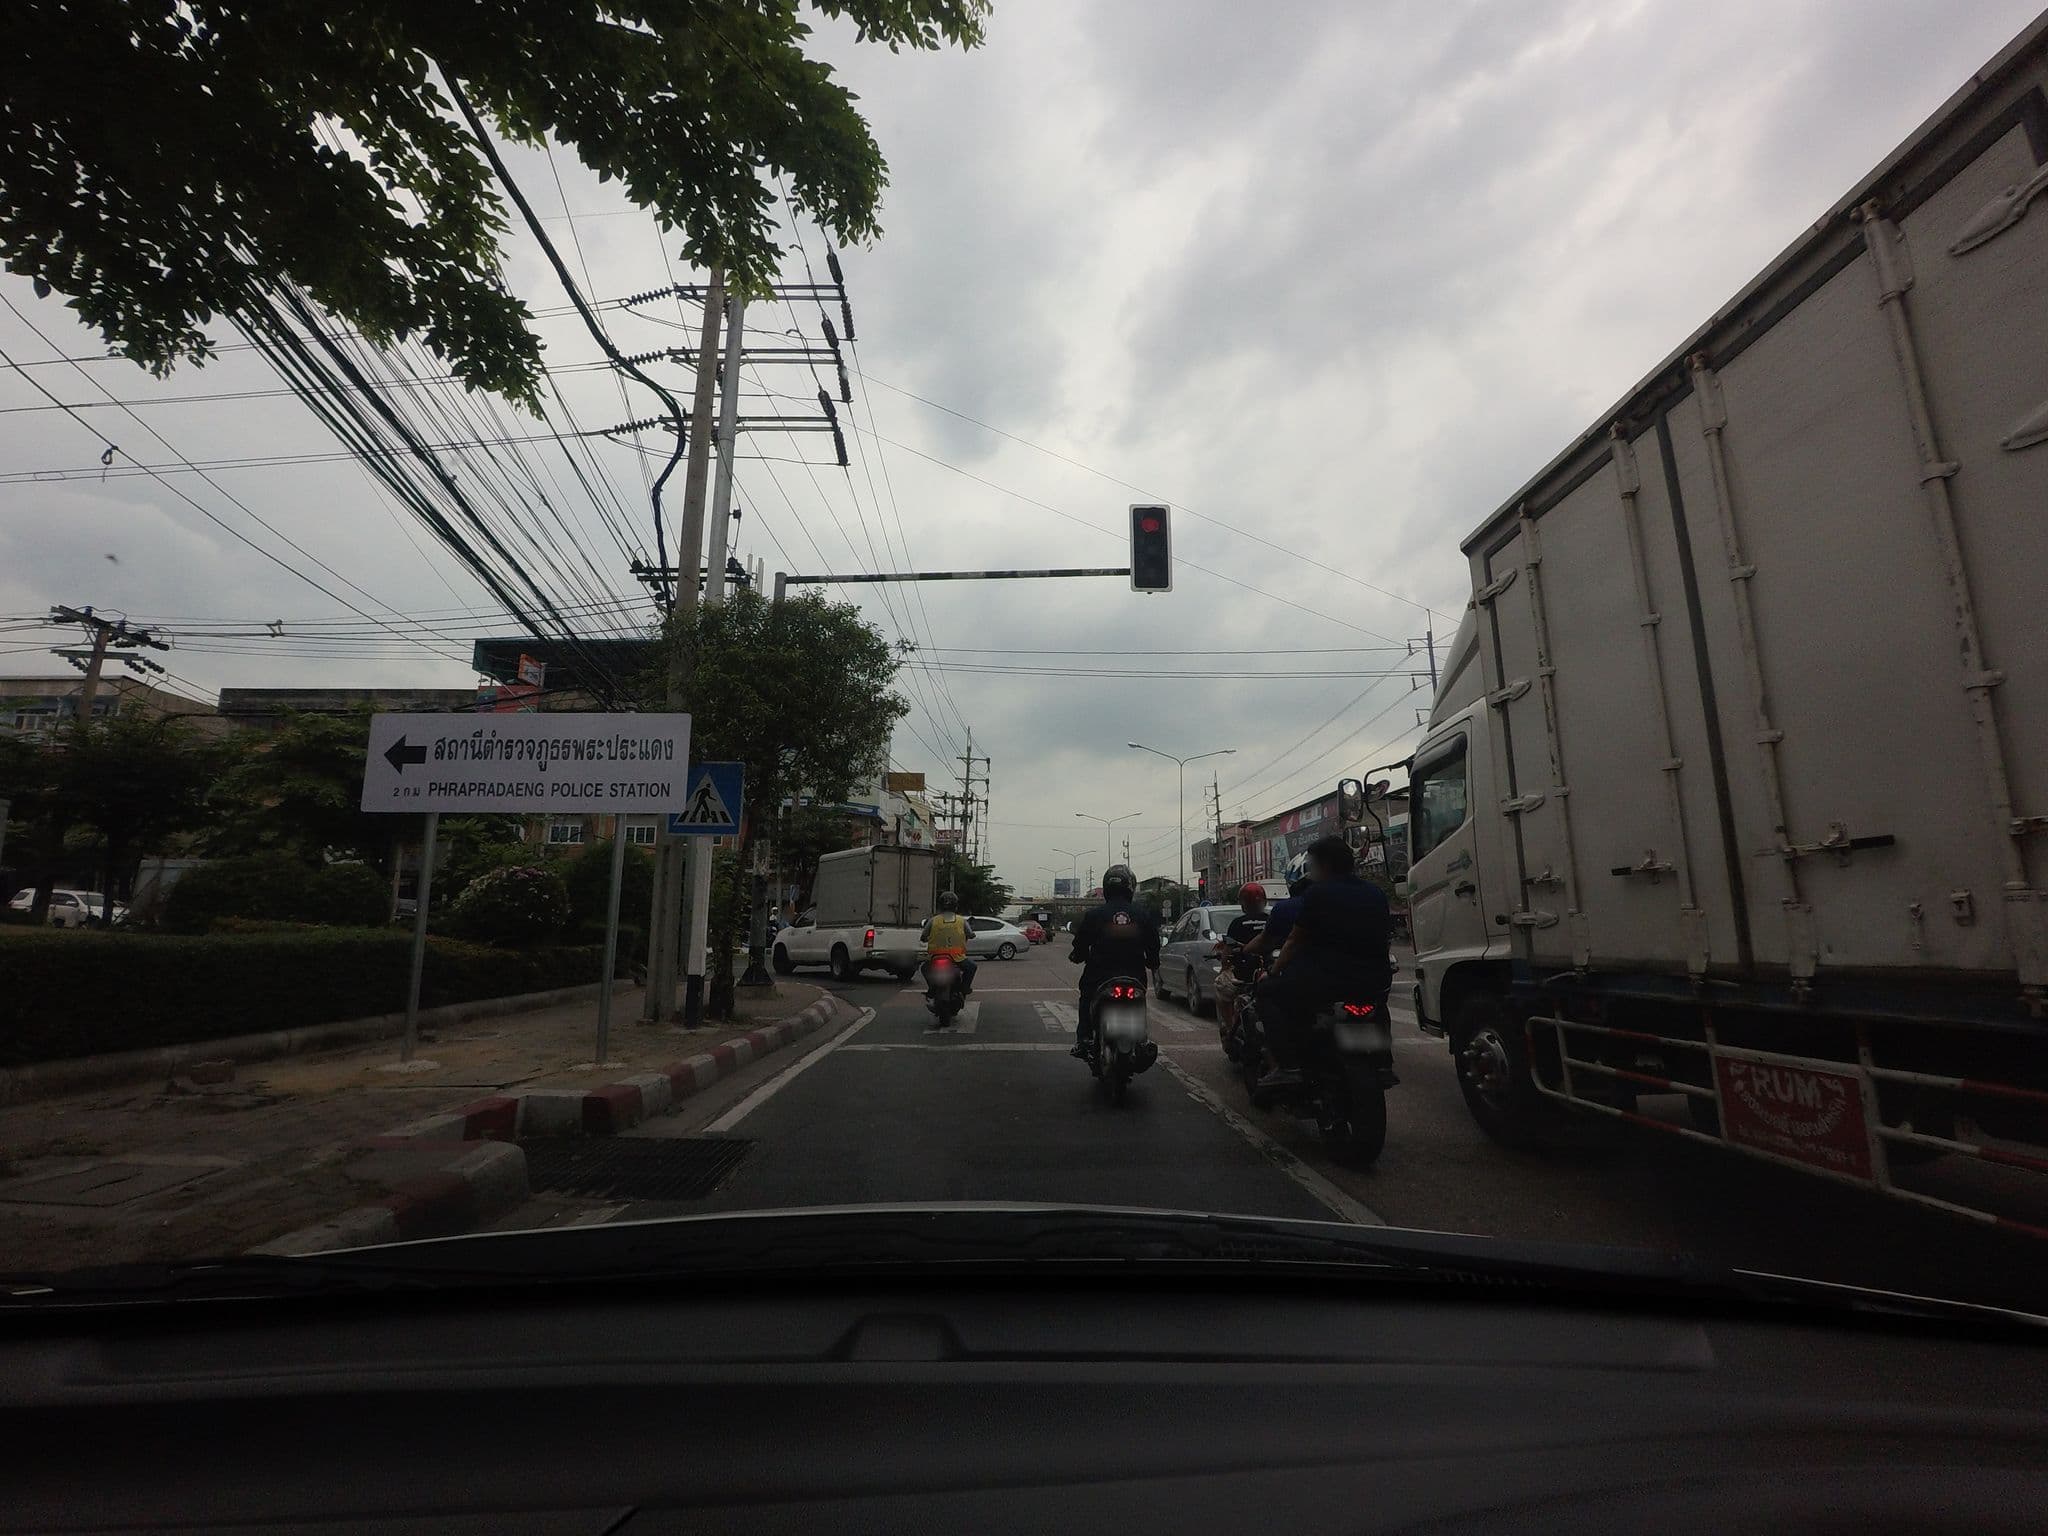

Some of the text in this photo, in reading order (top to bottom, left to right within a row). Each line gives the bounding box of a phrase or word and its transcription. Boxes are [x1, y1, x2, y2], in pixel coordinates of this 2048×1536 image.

[433, 729, 674, 771] สถานีตำรวจภูธรพระประแดง
[393, 787, 400, 797] 2
[428, 782, 545, 797] PHRAPRADAENG
[550, 782, 604, 797] POLICE
[609, 782, 671, 797] STATION
